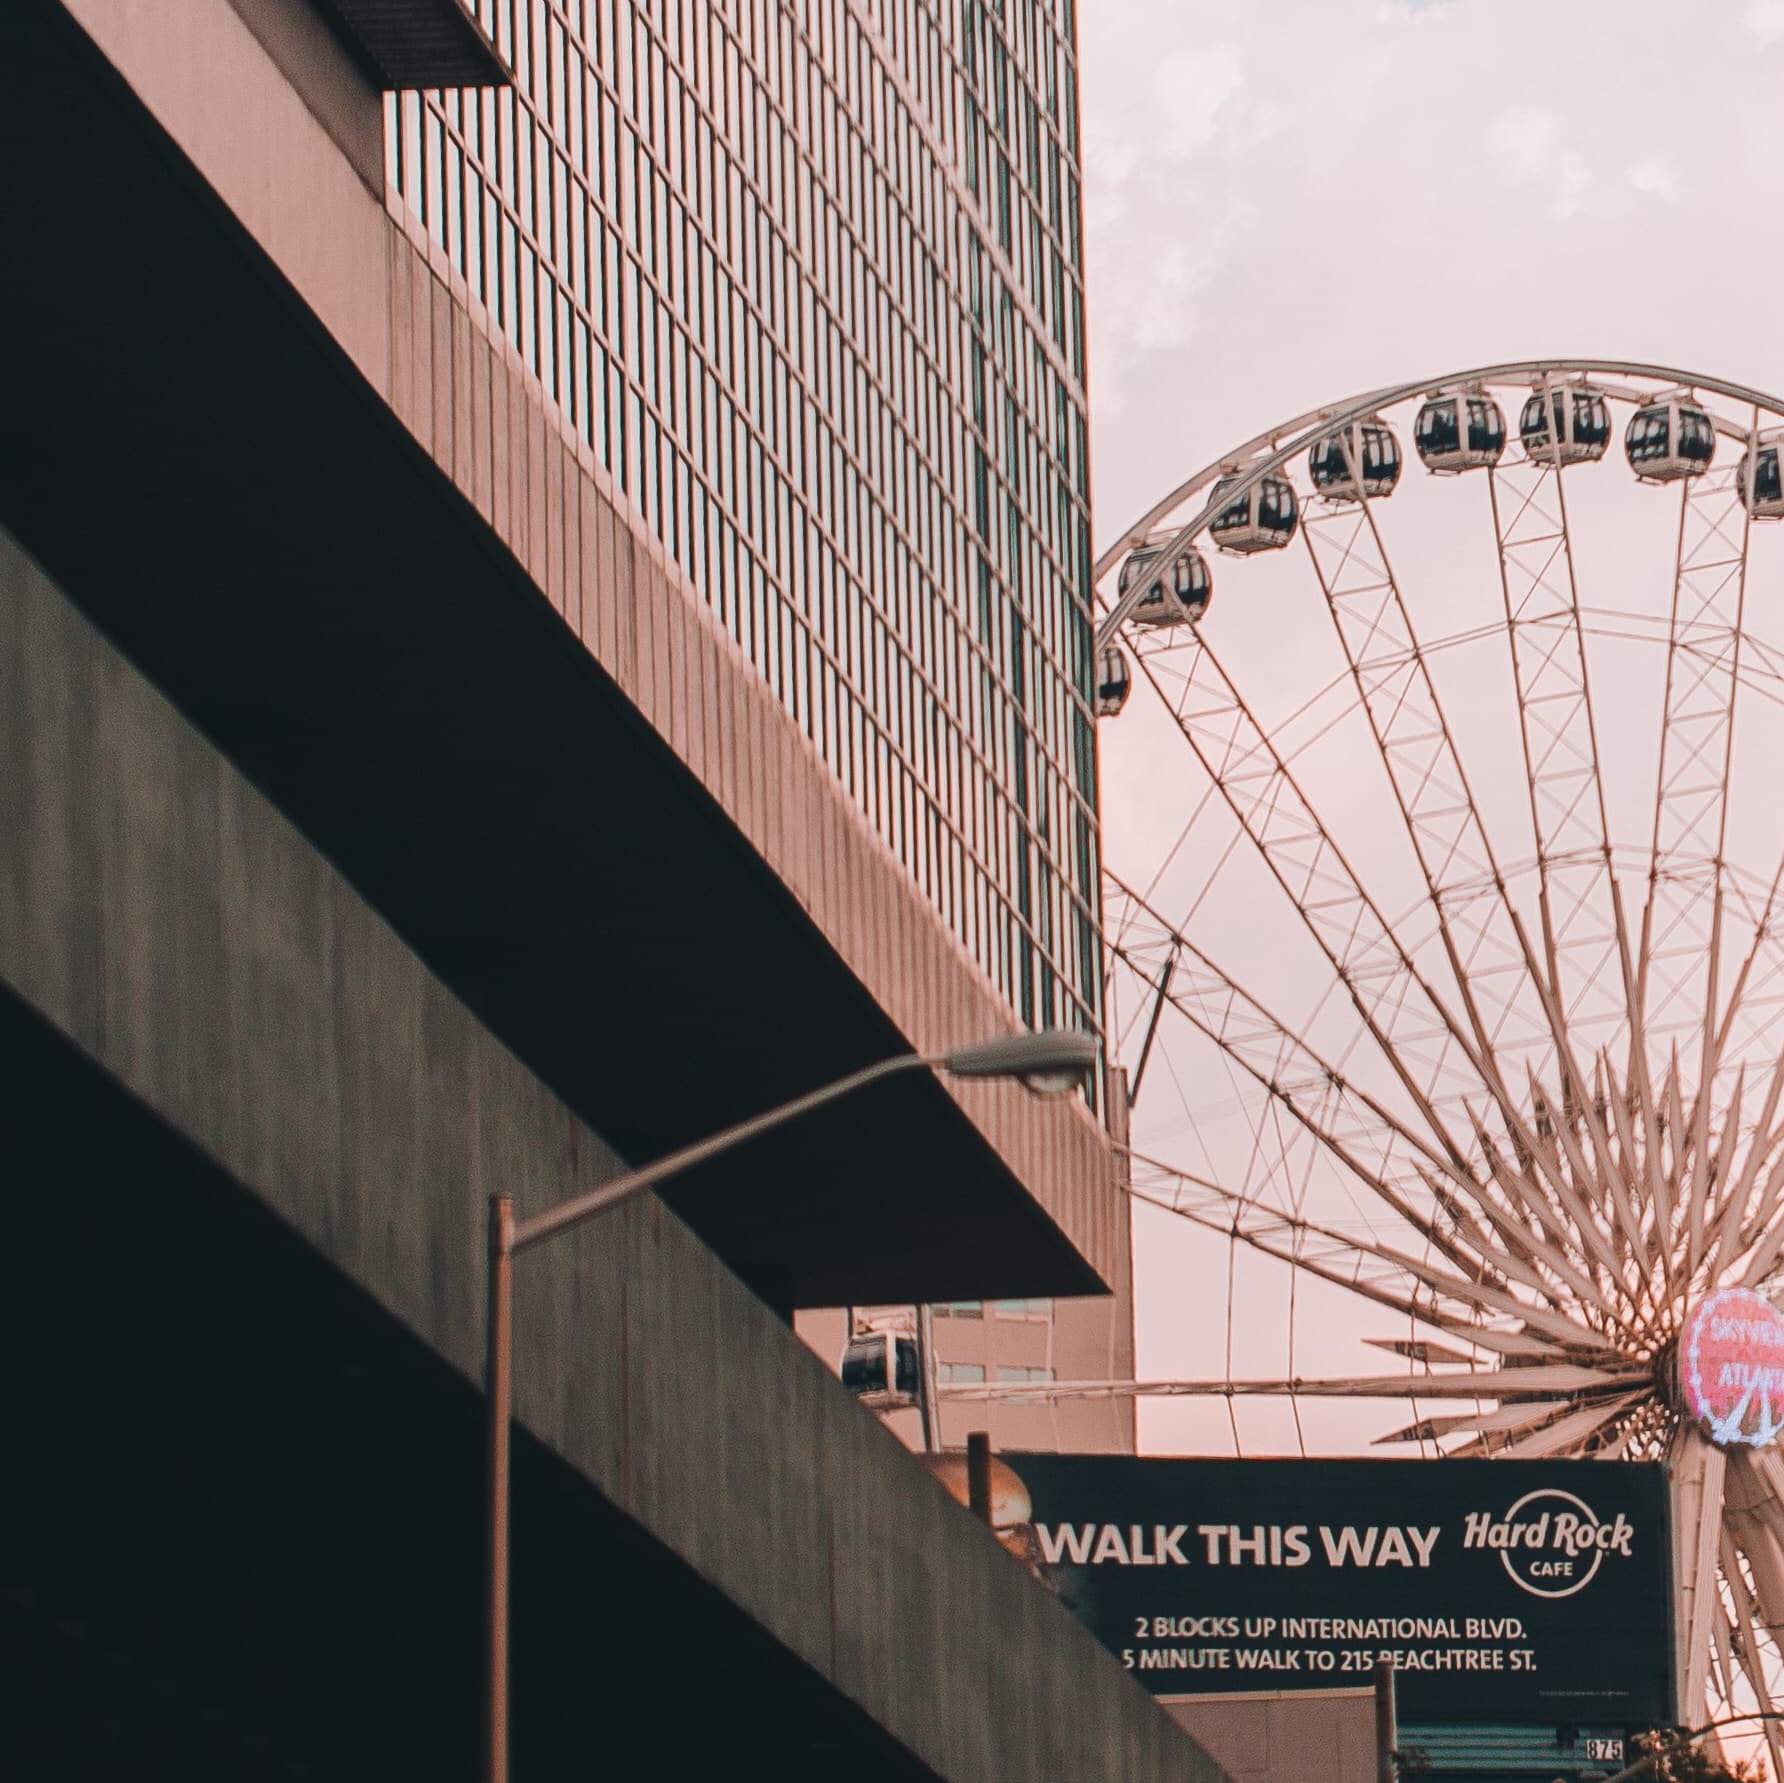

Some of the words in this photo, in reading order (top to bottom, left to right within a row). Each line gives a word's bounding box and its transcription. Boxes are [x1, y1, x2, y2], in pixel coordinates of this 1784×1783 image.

[1036, 1522, 1191, 1565] WALK
[1197, 1523, 1312, 1567] THIS
[1319, 1525, 1441, 1567] WAY
[1463, 1511, 1549, 1549] Hard
[1552, 1512, 1634, 1558] Rock
[1529, 1561, 1574, 1577] CAFE
[1134, 1617, 1150, 1638] 2
[1153, 1616, 1240, 1638] BLOCKS
[1245, 1617, 1276, 1638] UP
[1281, 1617, 1461, 1640] INTERNATIONAL
[1465, 1618, 1528, 1640] BLVD.
[1122, 1649, 1134, 1669] 5
[1139, 1649, 1231, 1670] MINUTE
[1235, 1649, 1301, 1670] WALK
[1304, 1649, 1336, 1670] TO
[1340, 1650, 1374, 1671] 215
[1509, 1650, 1537, 1671] ST.
[1587, 1741, 1622, 1759] 875
